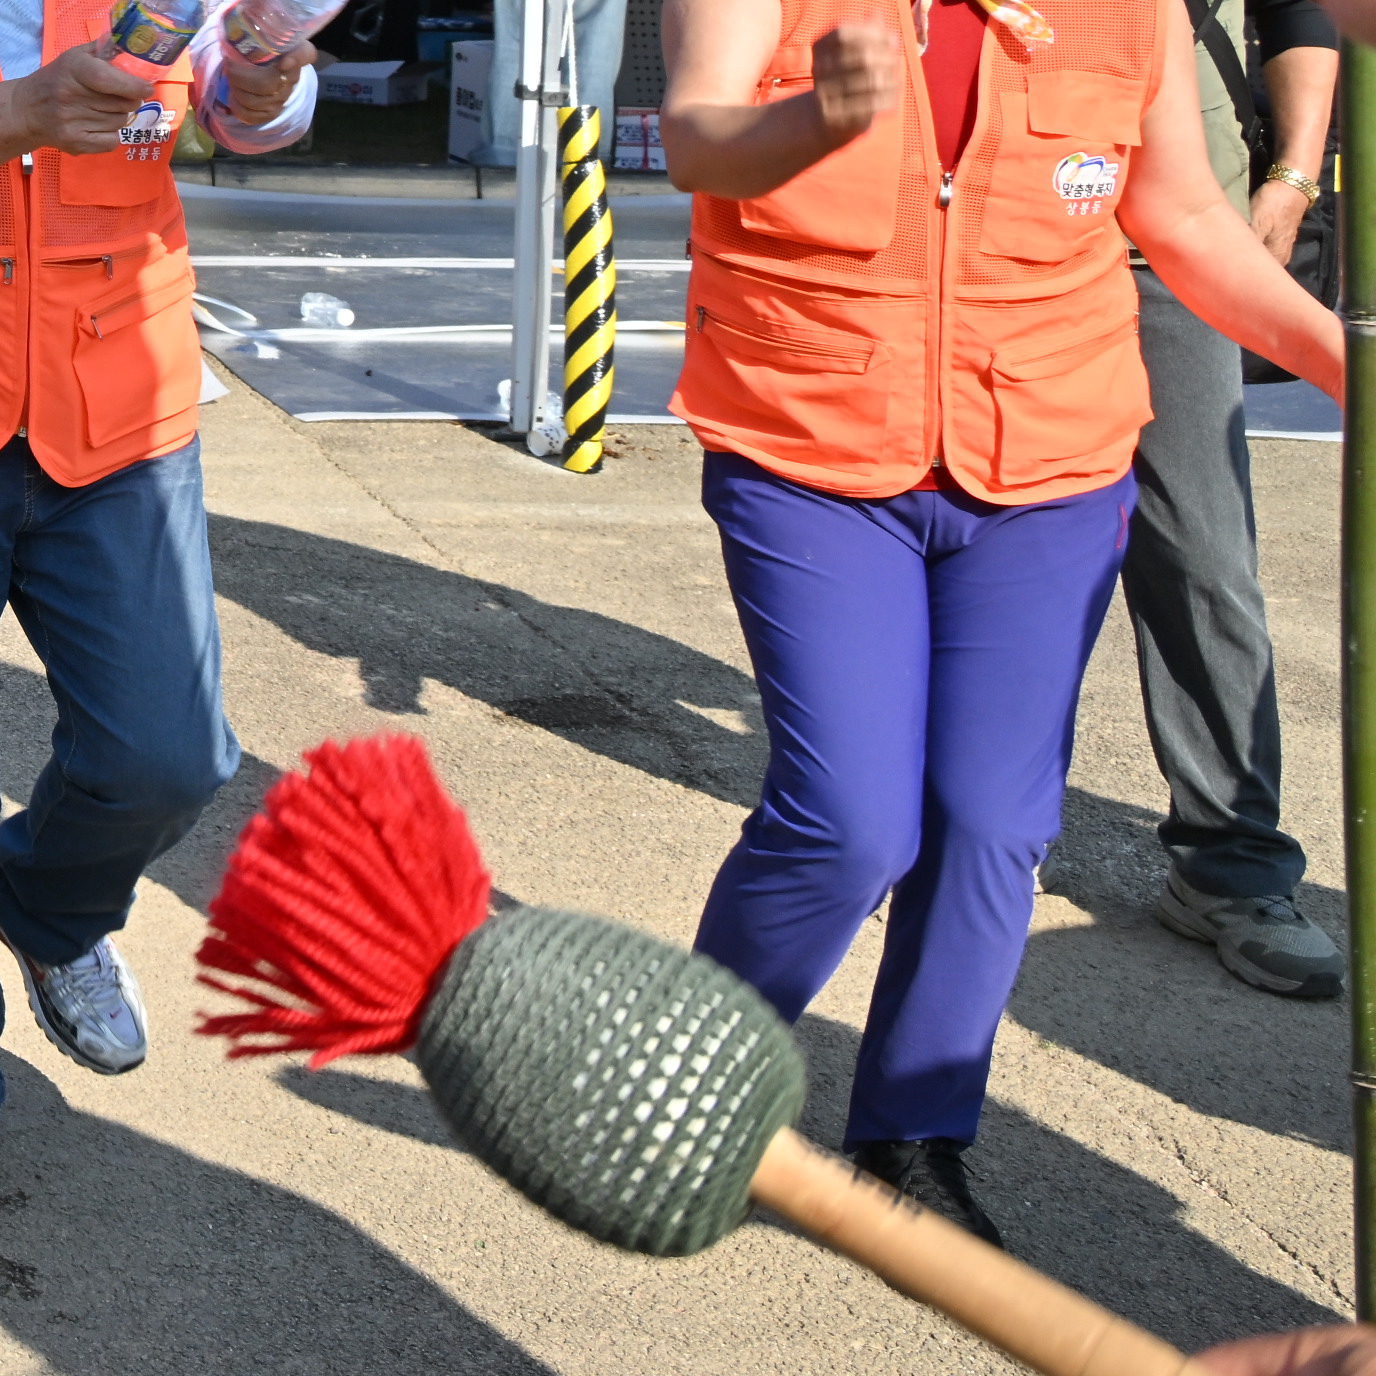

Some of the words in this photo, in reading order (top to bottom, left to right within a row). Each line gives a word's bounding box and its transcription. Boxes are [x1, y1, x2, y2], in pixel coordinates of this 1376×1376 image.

[121, 127, 152, 144] 맞춤형
[153, 128, 170, 143] 복지
[125, 146, 161, 161] 상봉동
[1062, 182, 1095, 198] 맞춤형
[1095, 182, 1113, 196] 복지
[1065, 200, 1102, 216] 상봉동
